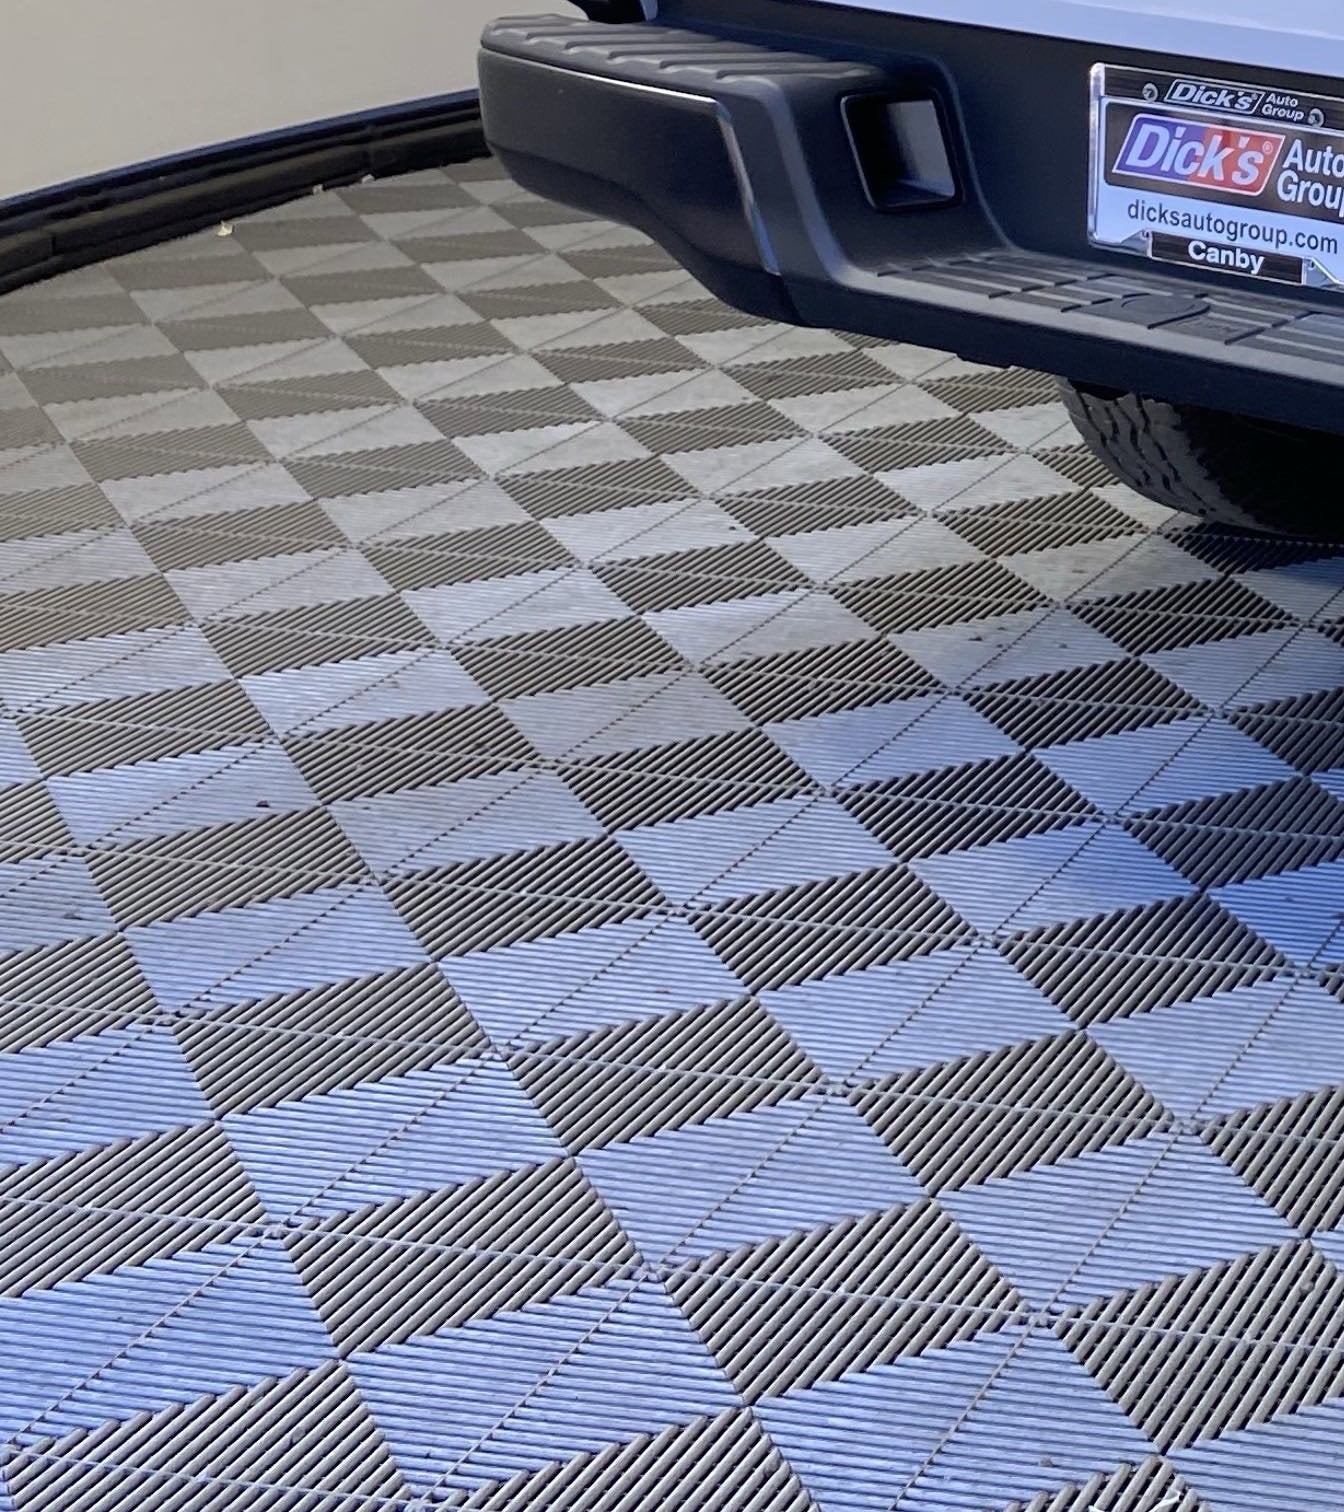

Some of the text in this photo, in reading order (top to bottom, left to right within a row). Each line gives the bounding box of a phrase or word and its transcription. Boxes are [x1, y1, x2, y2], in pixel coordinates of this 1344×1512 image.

[1170, 81, 1254, 112] Dick's
[1261, 103, 1305, 122] Group
[1265, 92, 1299, 108] Auto
[1125, 122, 1265, 187] Dick's
[1127, 199, 1339, 255] dicksautogroup.com
[1187, 240, 1266, 275] Canby
